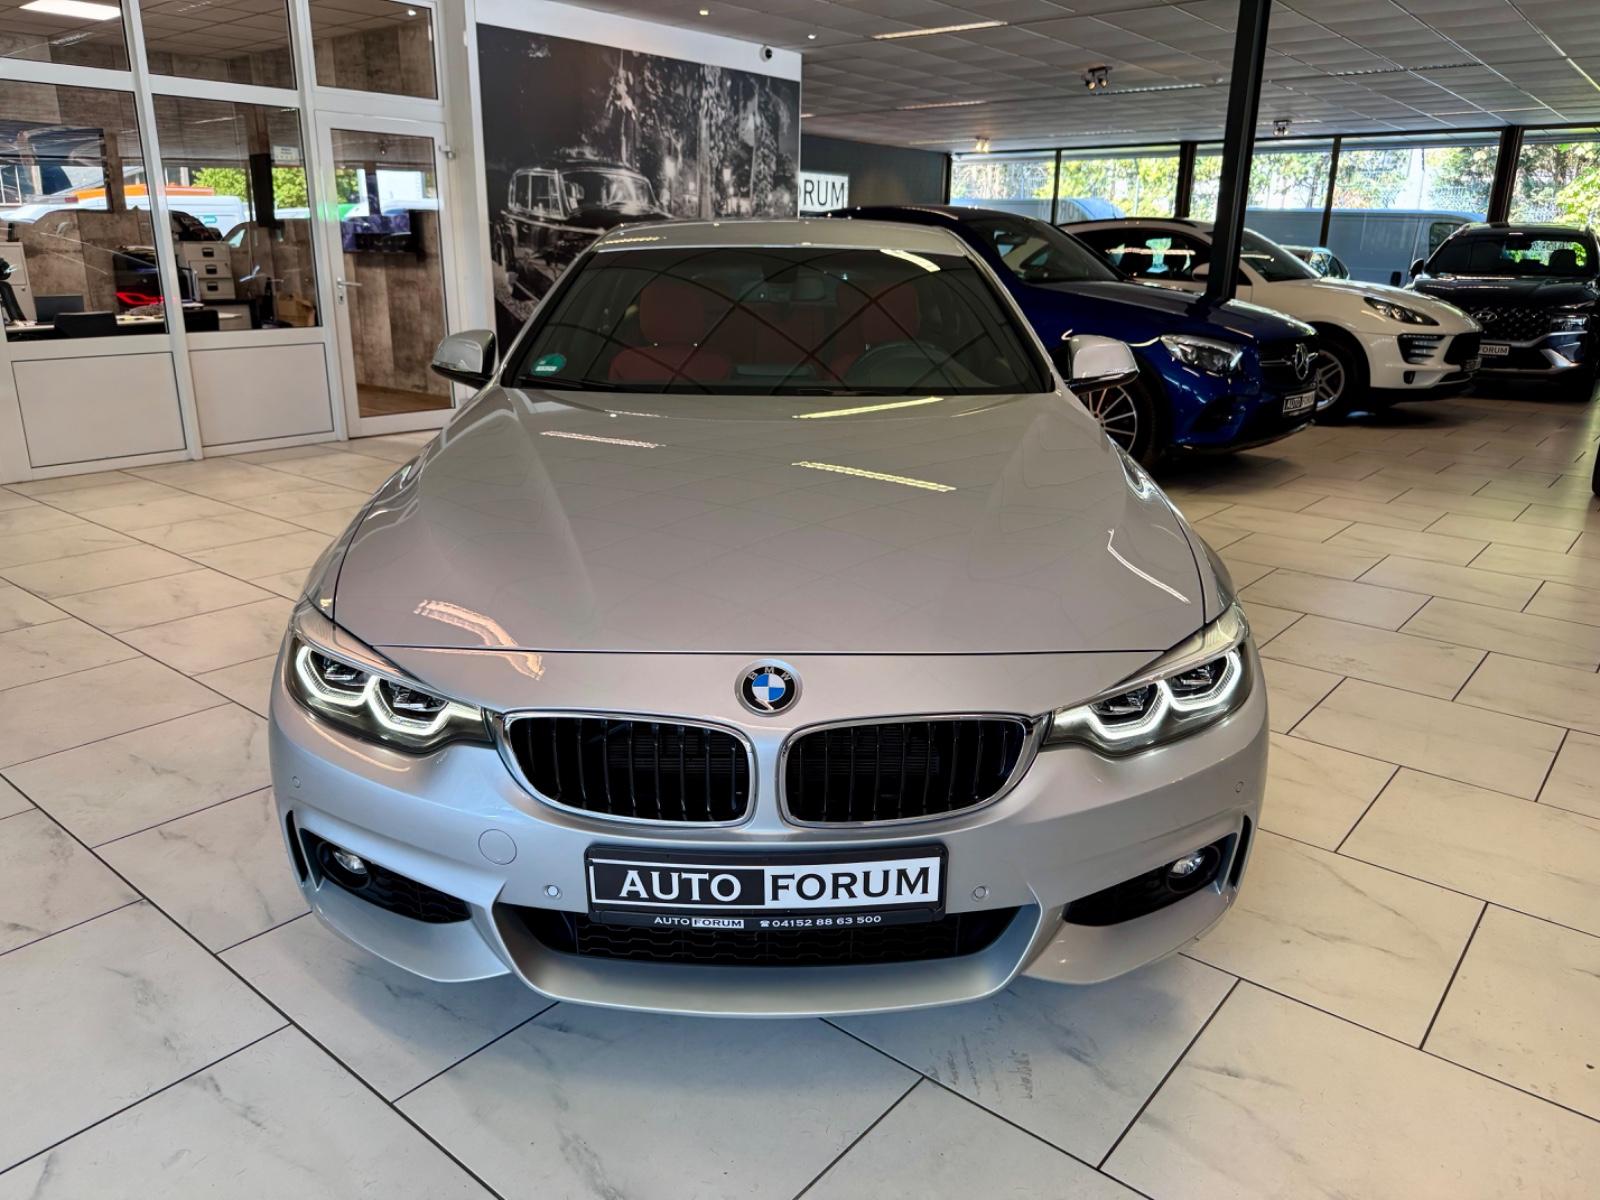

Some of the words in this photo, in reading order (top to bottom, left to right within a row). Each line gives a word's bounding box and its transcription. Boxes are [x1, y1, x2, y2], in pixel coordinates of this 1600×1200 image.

[799, 179, 845, 207] RUM
[748, 666, 792, 681] BMW
[619, 870, 742, 902] AUTO
[770, 867, 930, 901] FORUM
[654, 917, 690, 926] AUTO
[692, 919, 743, 928] FORUM
[772, 919, 813, 928] 04152
[816, 918, 833, 926] 88
[836, 917, 853, 925] 63
[857, 915, 882, 924] 500
